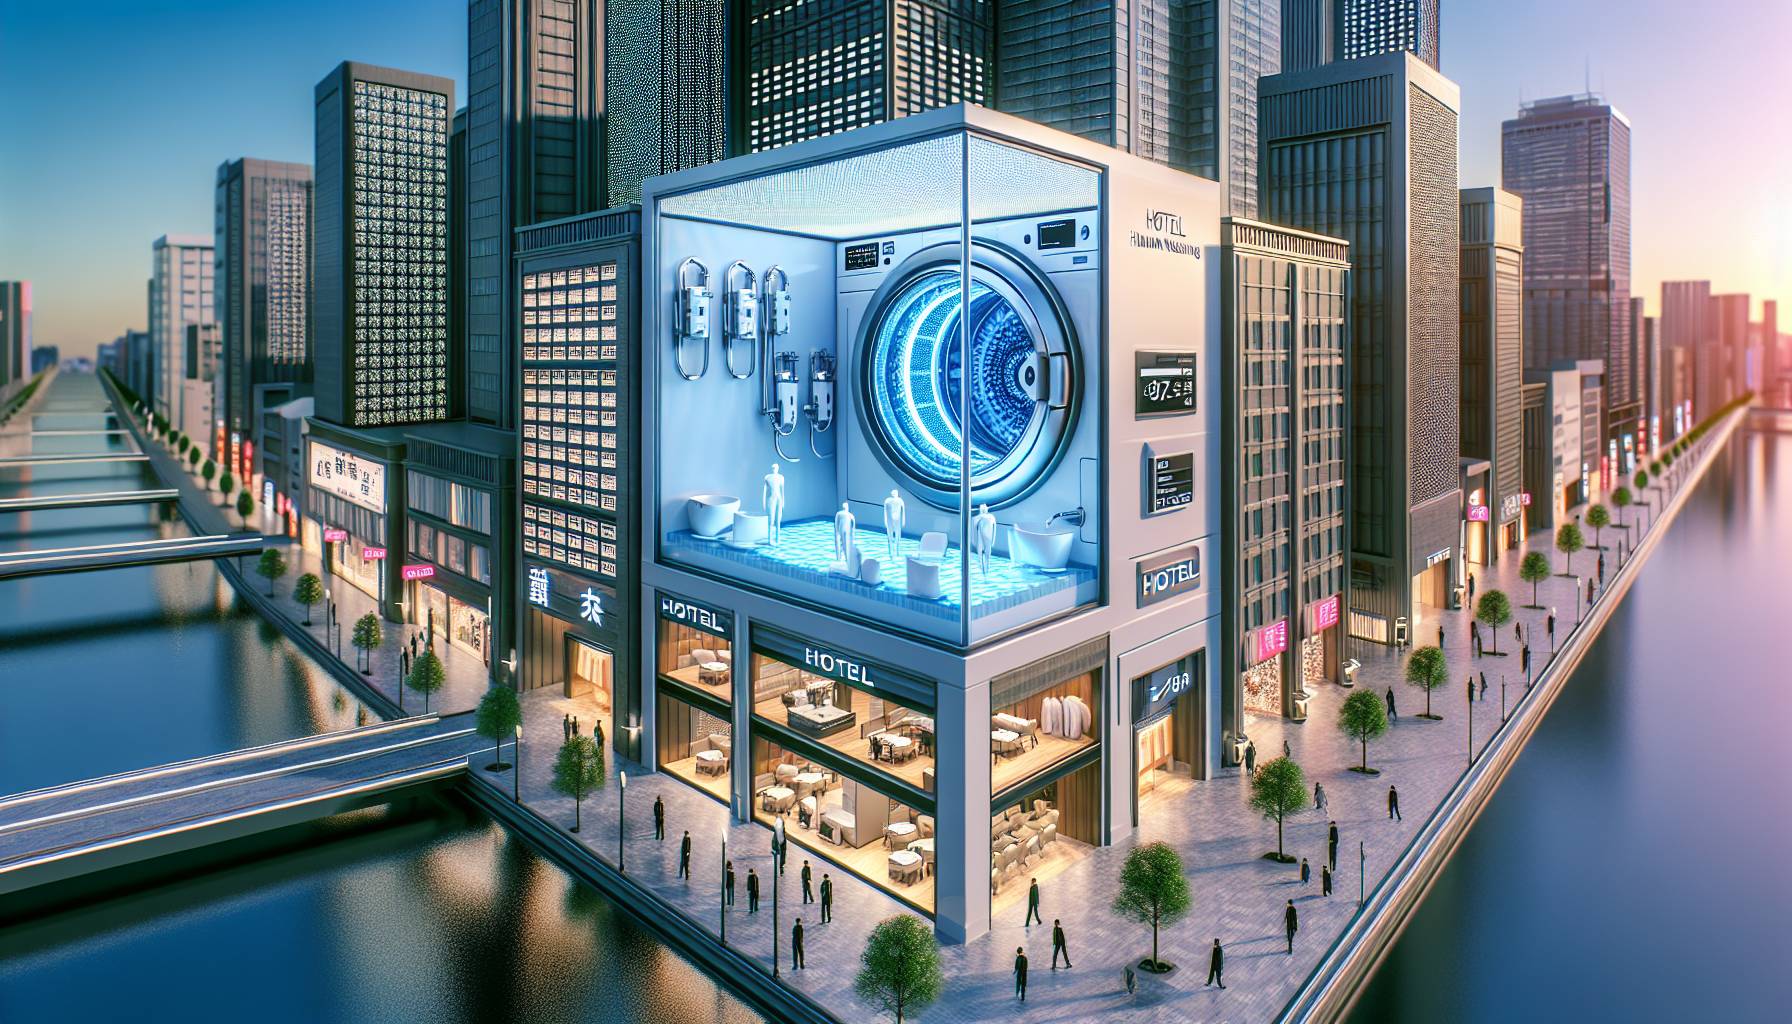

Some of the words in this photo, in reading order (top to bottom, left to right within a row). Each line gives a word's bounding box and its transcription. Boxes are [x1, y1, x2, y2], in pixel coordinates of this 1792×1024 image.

[1146, 208, 1186, 237] HOTEL
[1143, 560, 1200, 596] HOTEL
[662, 598, 725, 632] HOTEL
[805, 647, 875, 687] HOTEL
